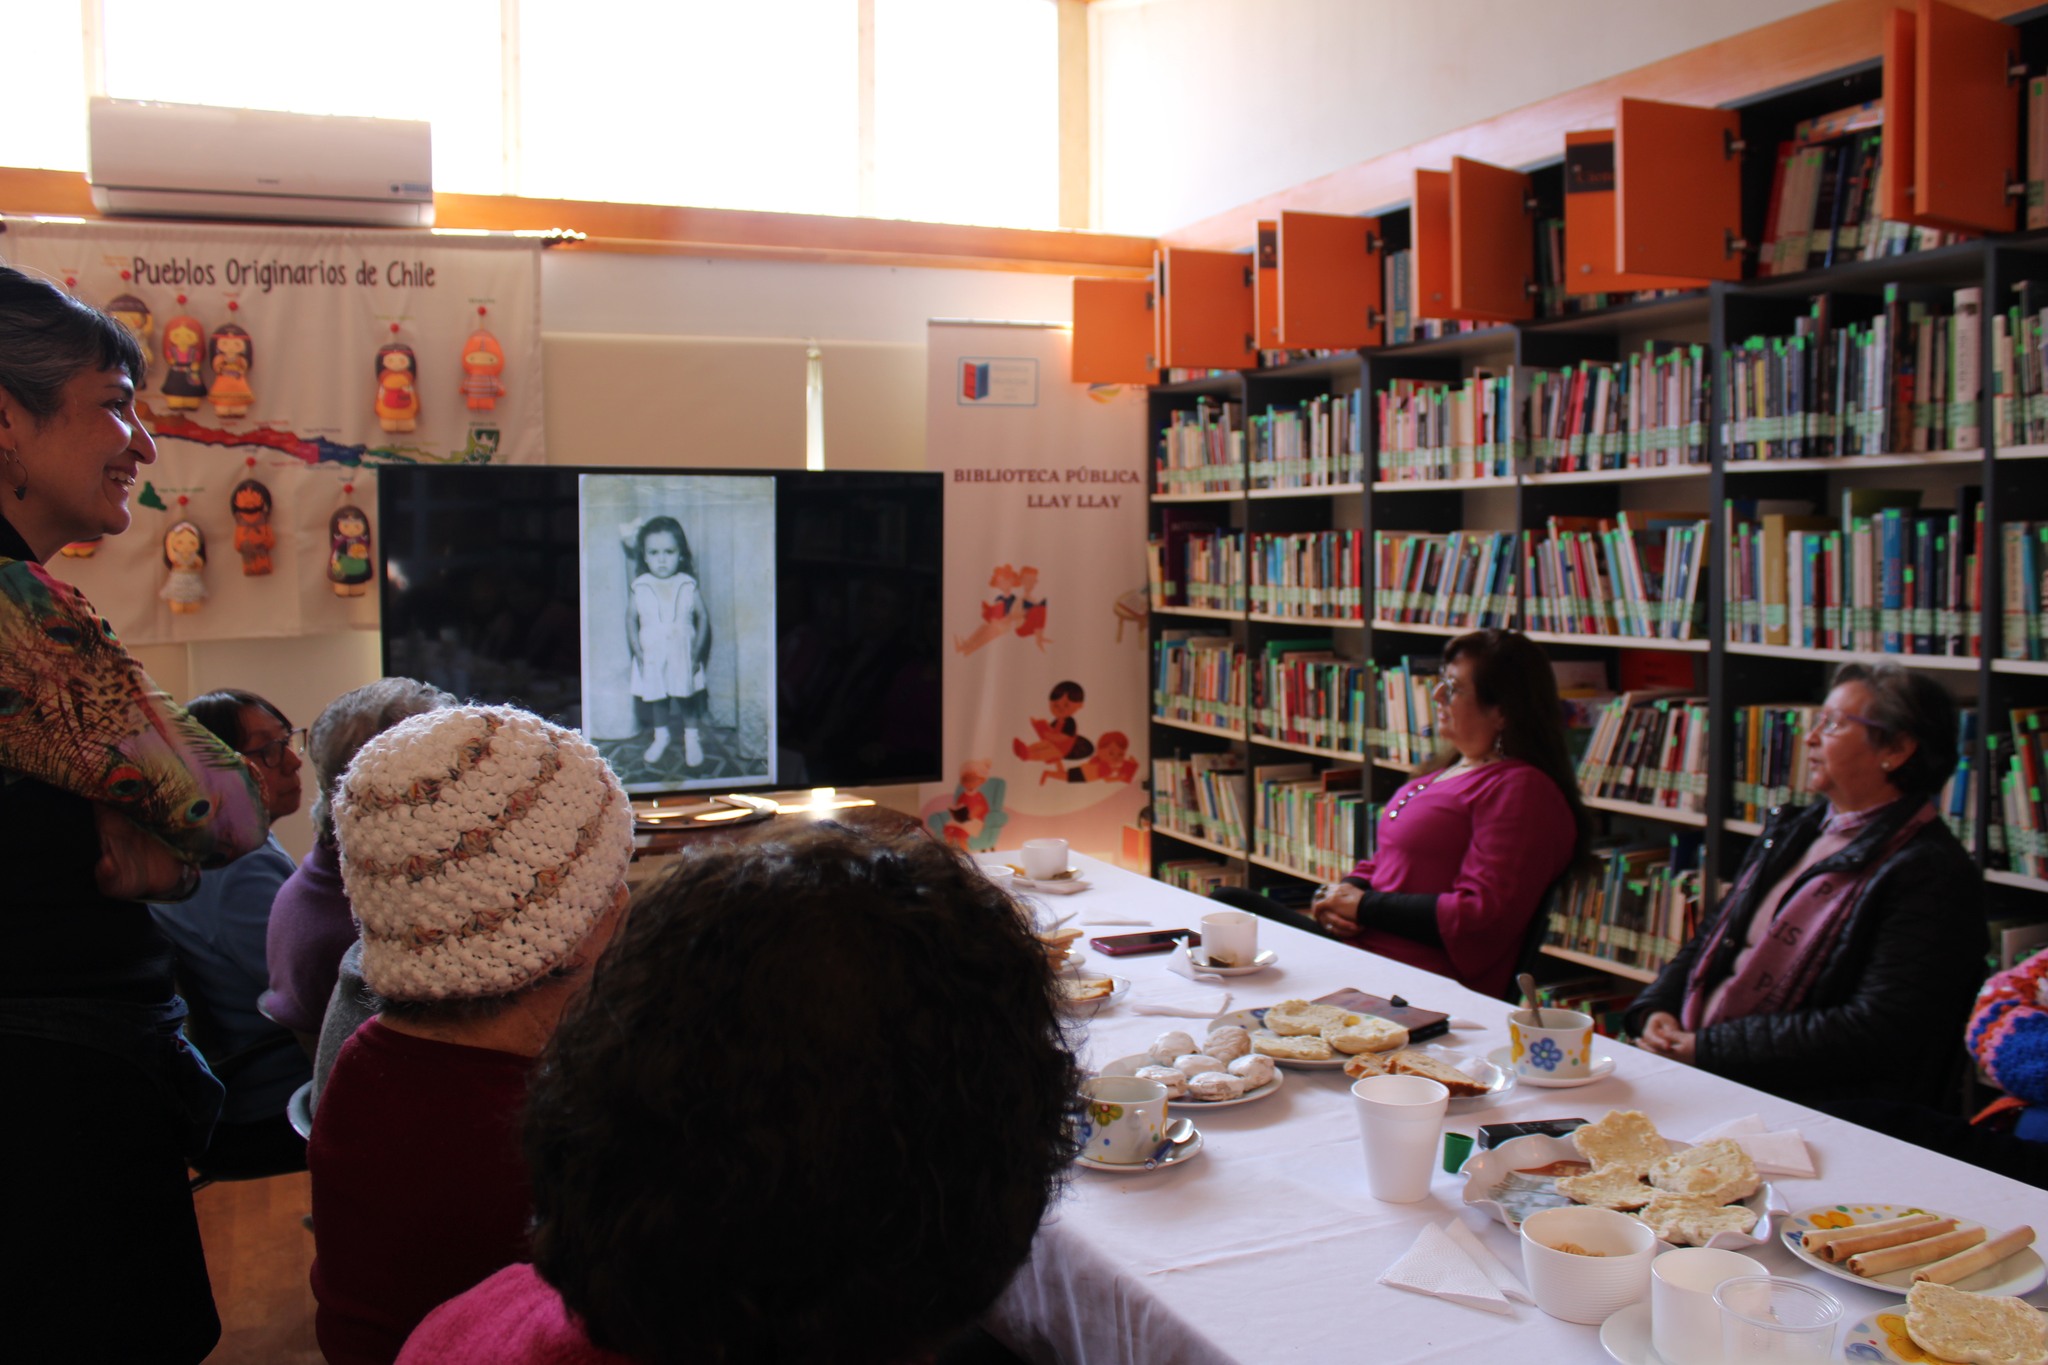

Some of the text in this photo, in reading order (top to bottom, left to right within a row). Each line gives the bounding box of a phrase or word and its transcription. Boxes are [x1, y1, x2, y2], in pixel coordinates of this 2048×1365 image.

[133, 256, 216, 286] Pueblos
[225, 257, 348, 294] Originarios
[356, 259, 378, 287] de
[386, 260, 436, 288] Chile
[953, 465, 1141, 484] BIBLIOTECA PÚBLICA
[1027, 493, 1123, 509] LLAY LLAY
